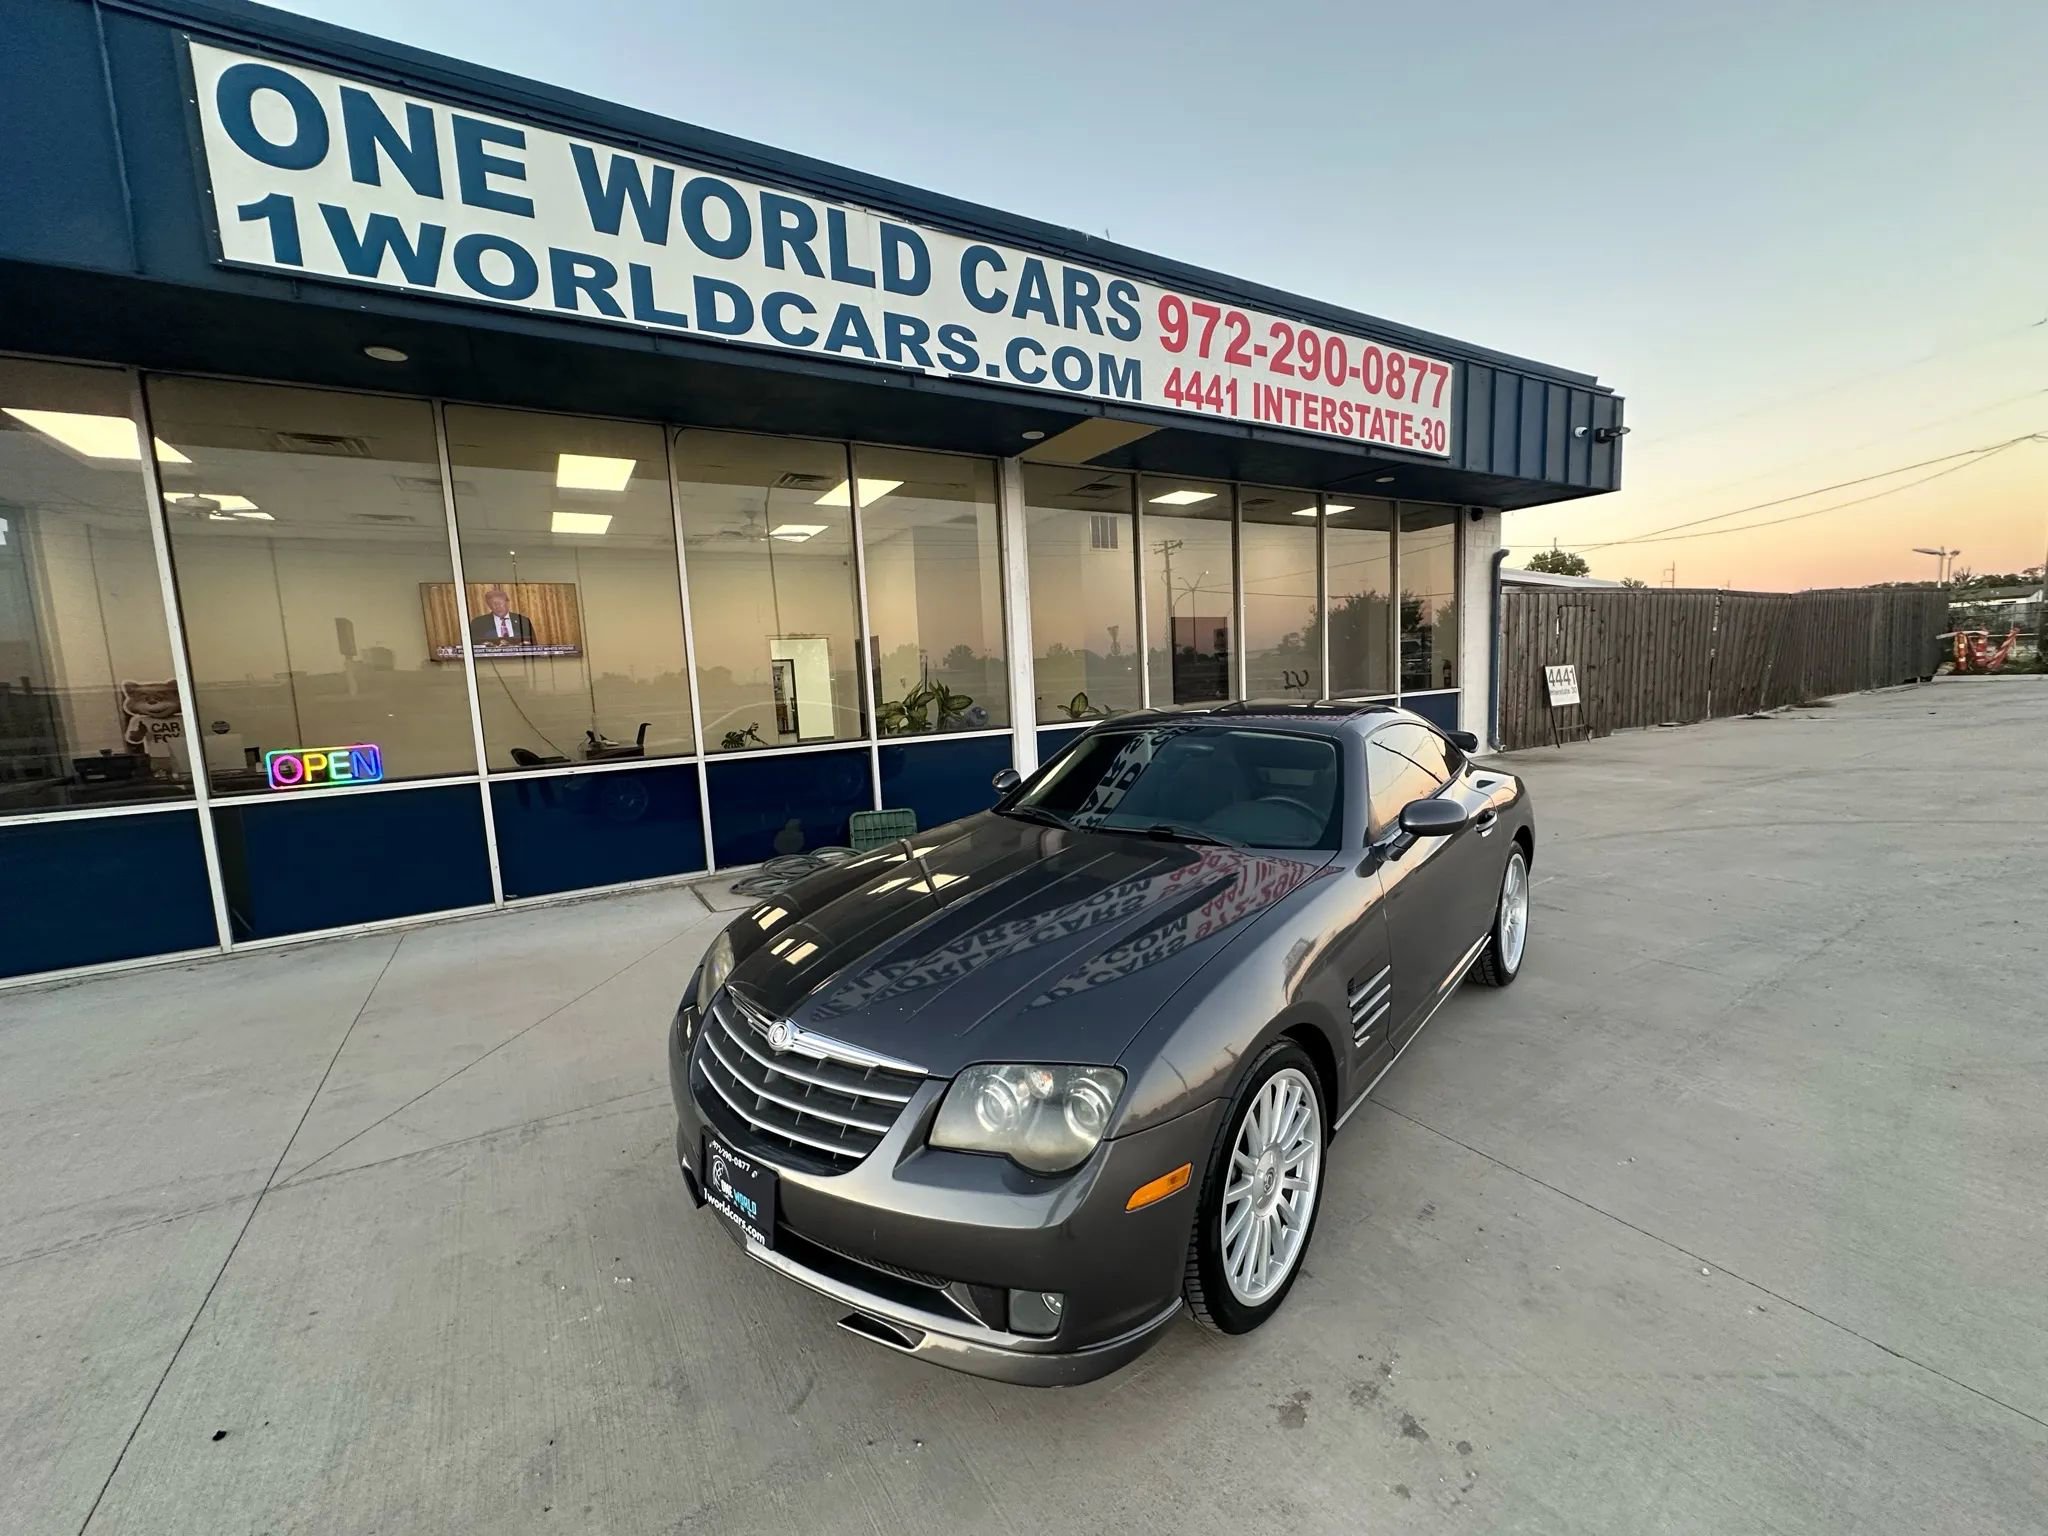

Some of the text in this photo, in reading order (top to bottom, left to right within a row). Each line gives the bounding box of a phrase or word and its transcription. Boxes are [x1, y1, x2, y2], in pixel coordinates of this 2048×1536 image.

[216, 62, 1142, 342] ONE WORLD CARS
[238, 192, 1143, 402] 1WORLDCARS.COM
[1158, 294, 1450, 409] 972-290-0877
[1163, 366, 1446, 453] 4441 INTERSTATE-30
[1548, 668, 1576, 687] 4441
[273, 750, 377, 784] OPEN
[703, 1187, 766, 1246] 1worldcars.com
[733, 1188, 757, 1216] WORLD
